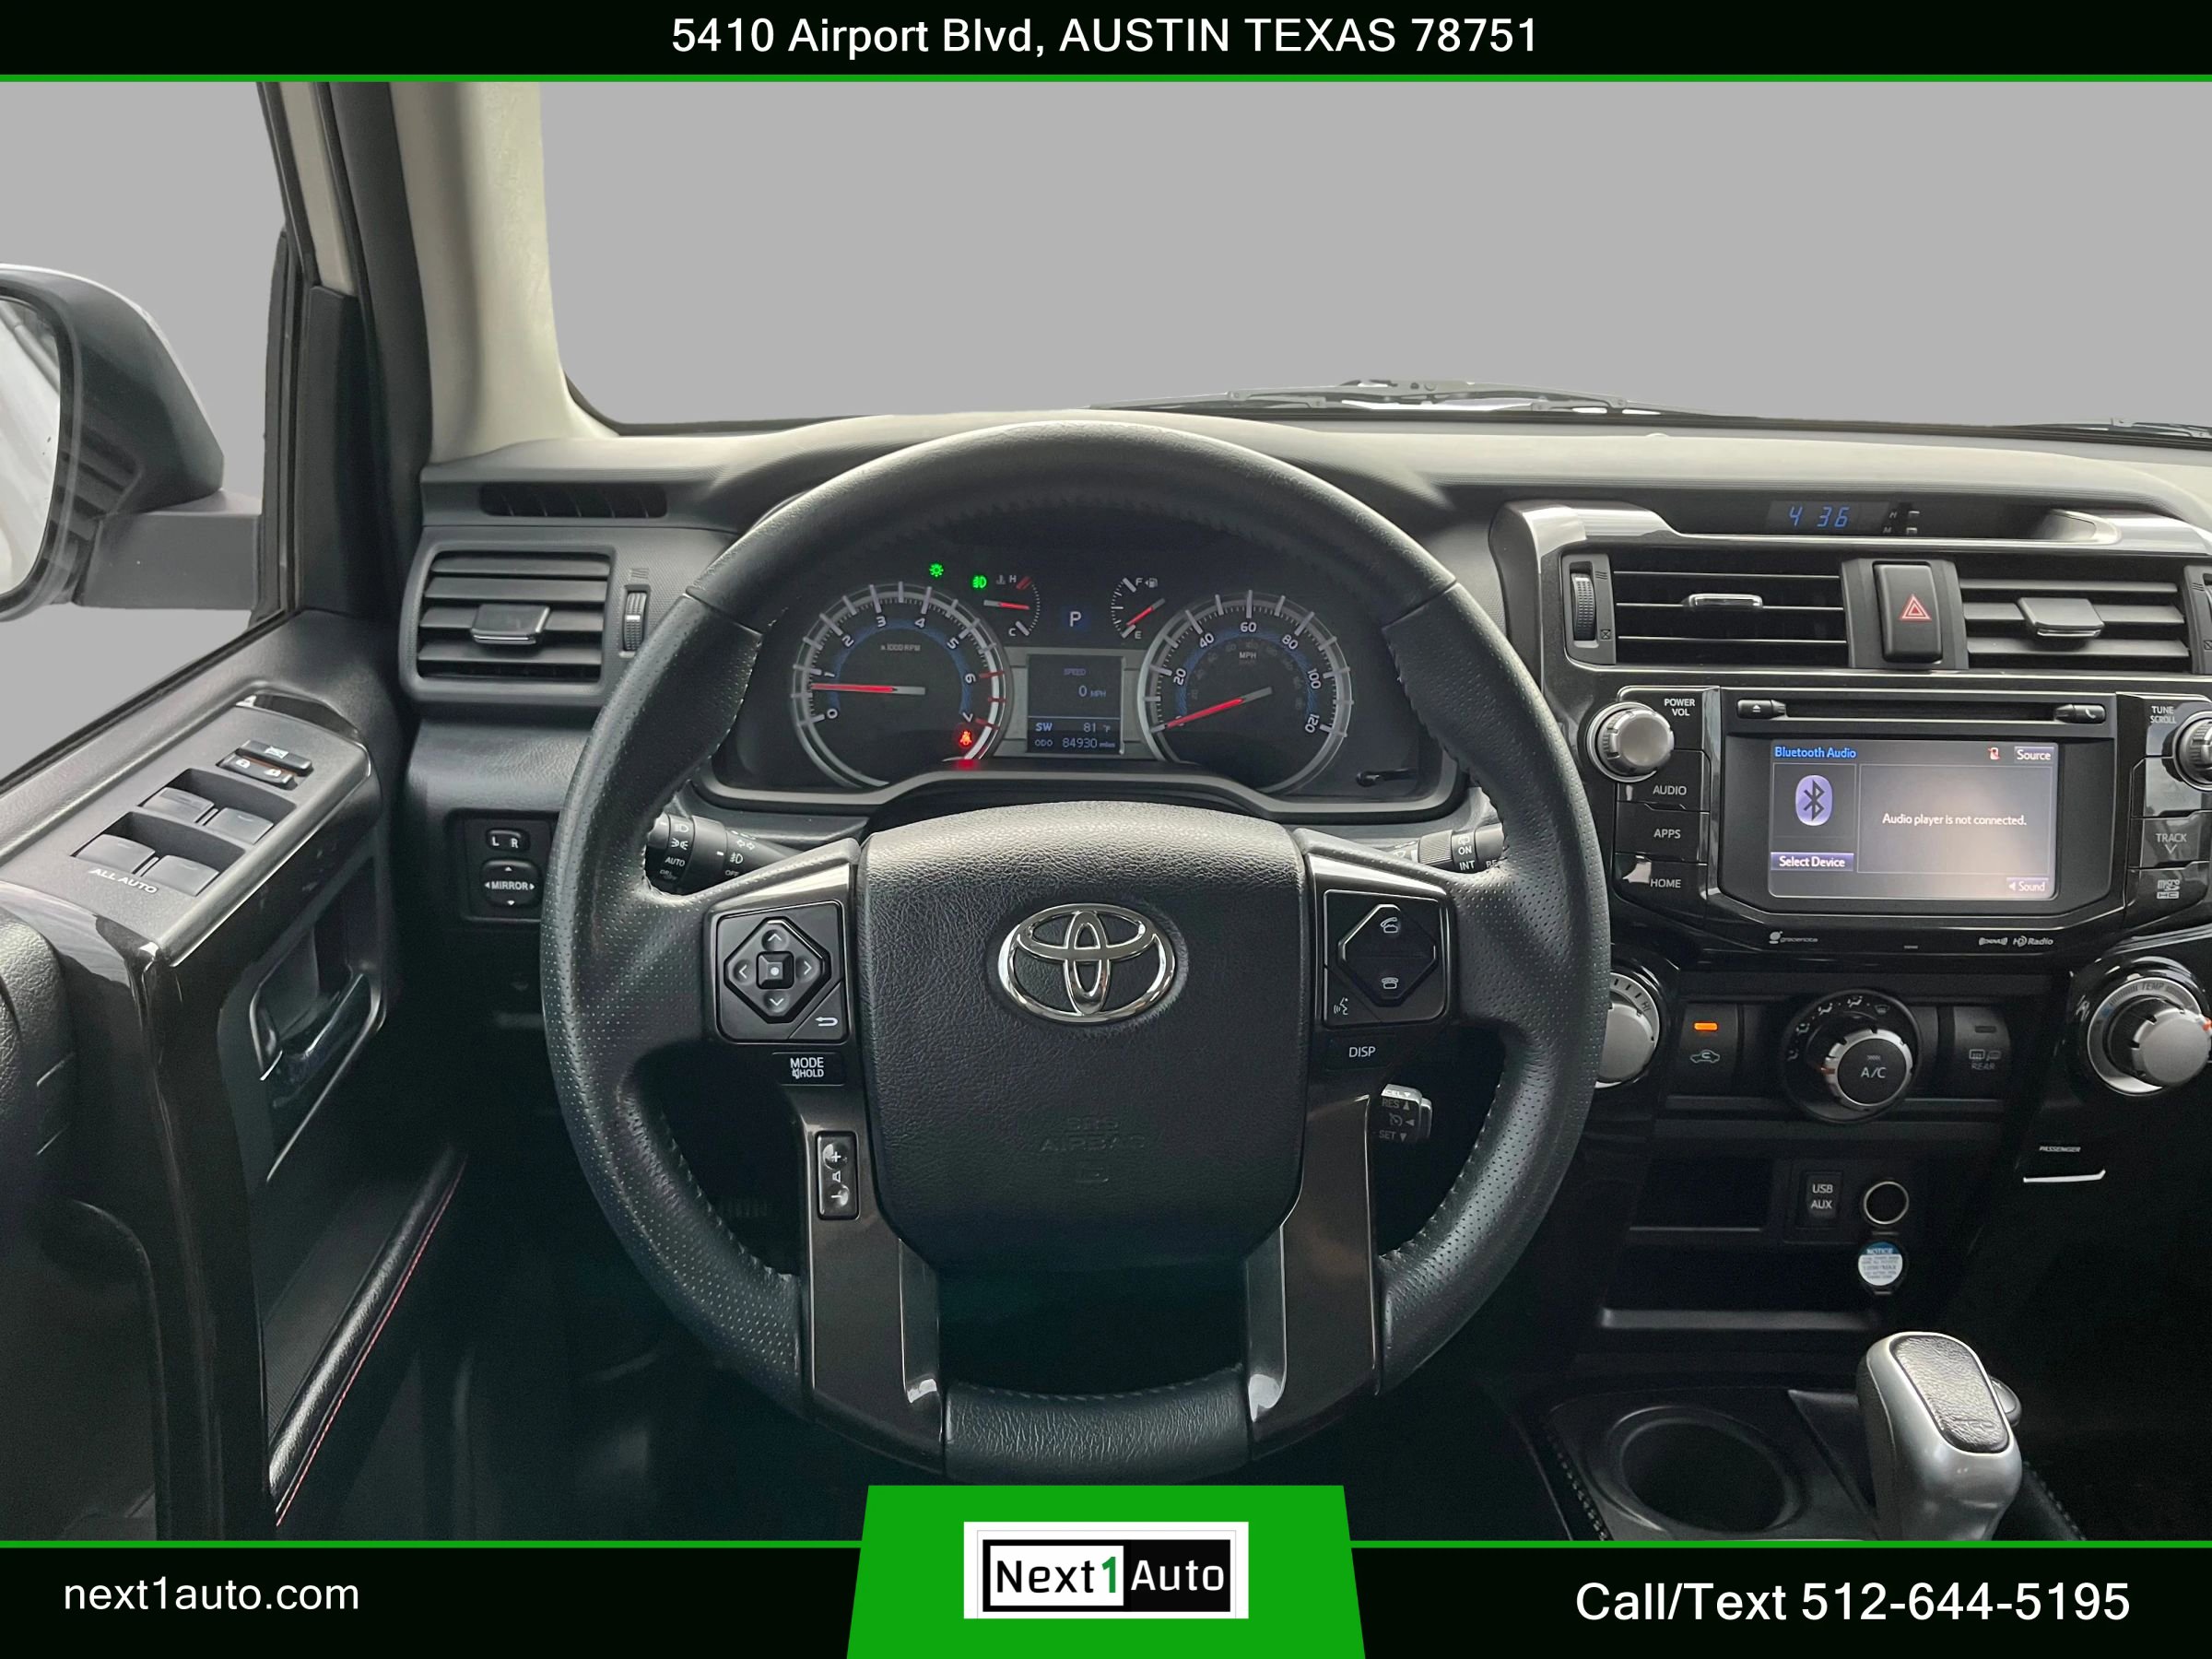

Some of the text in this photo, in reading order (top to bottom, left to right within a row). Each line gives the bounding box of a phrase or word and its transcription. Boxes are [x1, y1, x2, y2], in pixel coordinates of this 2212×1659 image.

[1008, 574, 1017, 583] H
[1135, 577, 1144, 586] F
[876, 616, 887, 628] 3
[914, 618, 925, 629] 4
[1069, 610, 1082, 628] P
[1008, 628, 1017, 637] C
[1240, 621, 1257, 633] 60
[1135, 630, 1142, 640] E
[1199, 632, 1215, 649] 40
[841, 635, 855, 647] 2
[947, 637, 959, 650] 5
[1281, 634, 1299, 650] 80
[1239, 651, 1257, 659] MPH
[965, 673, 977, 684] 6
[1173, 667, 1187, 686] 20
[1307, 667, 1322, 689] 100
[1078, 685, 1088, 698] 0
[1664, 698, 1696, 708] POWER
[826, 708, 839, 720] 0
[1671, 708, 1690, 716] VOL
[2151, 705, 2174, 714] TUNE
[962, 712, 973, 723] 7
[2150, 715, 2177, 724] SCROLL
[1035, 722, 1053, 732] SW
[1083, 722, 1097, 733] 81
[1305, 713, 1320, 734] 120
[1062, 737, 1098, 748] 84930
[1774, 746, 1856, 759] Bluetooth Audio
[2016, 748, 2052, 760] Source
[1653, 785, 1687, 795] AUDIO
[1882, 813, 2028, 826] Audio player is not connected.
[1653, 829, 1681, 840] APPS
[2156, 832, 2187, 843] TRACK
[491, 836, 500, 847] L
[511, 838, 519, 849] R
[1458, 845, 1472, 855] ON
[665, 856, 686, 867] AUTO
[1459, 860, 1476, 871] INT
[1779, 855, 1845, 867] Select Device
[88, 868, 159, 894] ALL AUTO
[491, 880, 529, 890] MIRROR
[1650, 878, 1682, 888] HOME
[2018, 881, 2045, 892] Sound
[2028, 937, 2054, 946] Radio
[1348, 1046, 1376, 1058] DISP
[790, 1057, 825, 1068] MODE
[799, 1068, 825, 1078] HOLD
[1860, 1066, 1887, 1078] A/C
[1378, 1129, 1396, 1140] SET
[1812, 1183, 1833, 1194] USB
[1810, 1200, 1832, 1209] AUX
